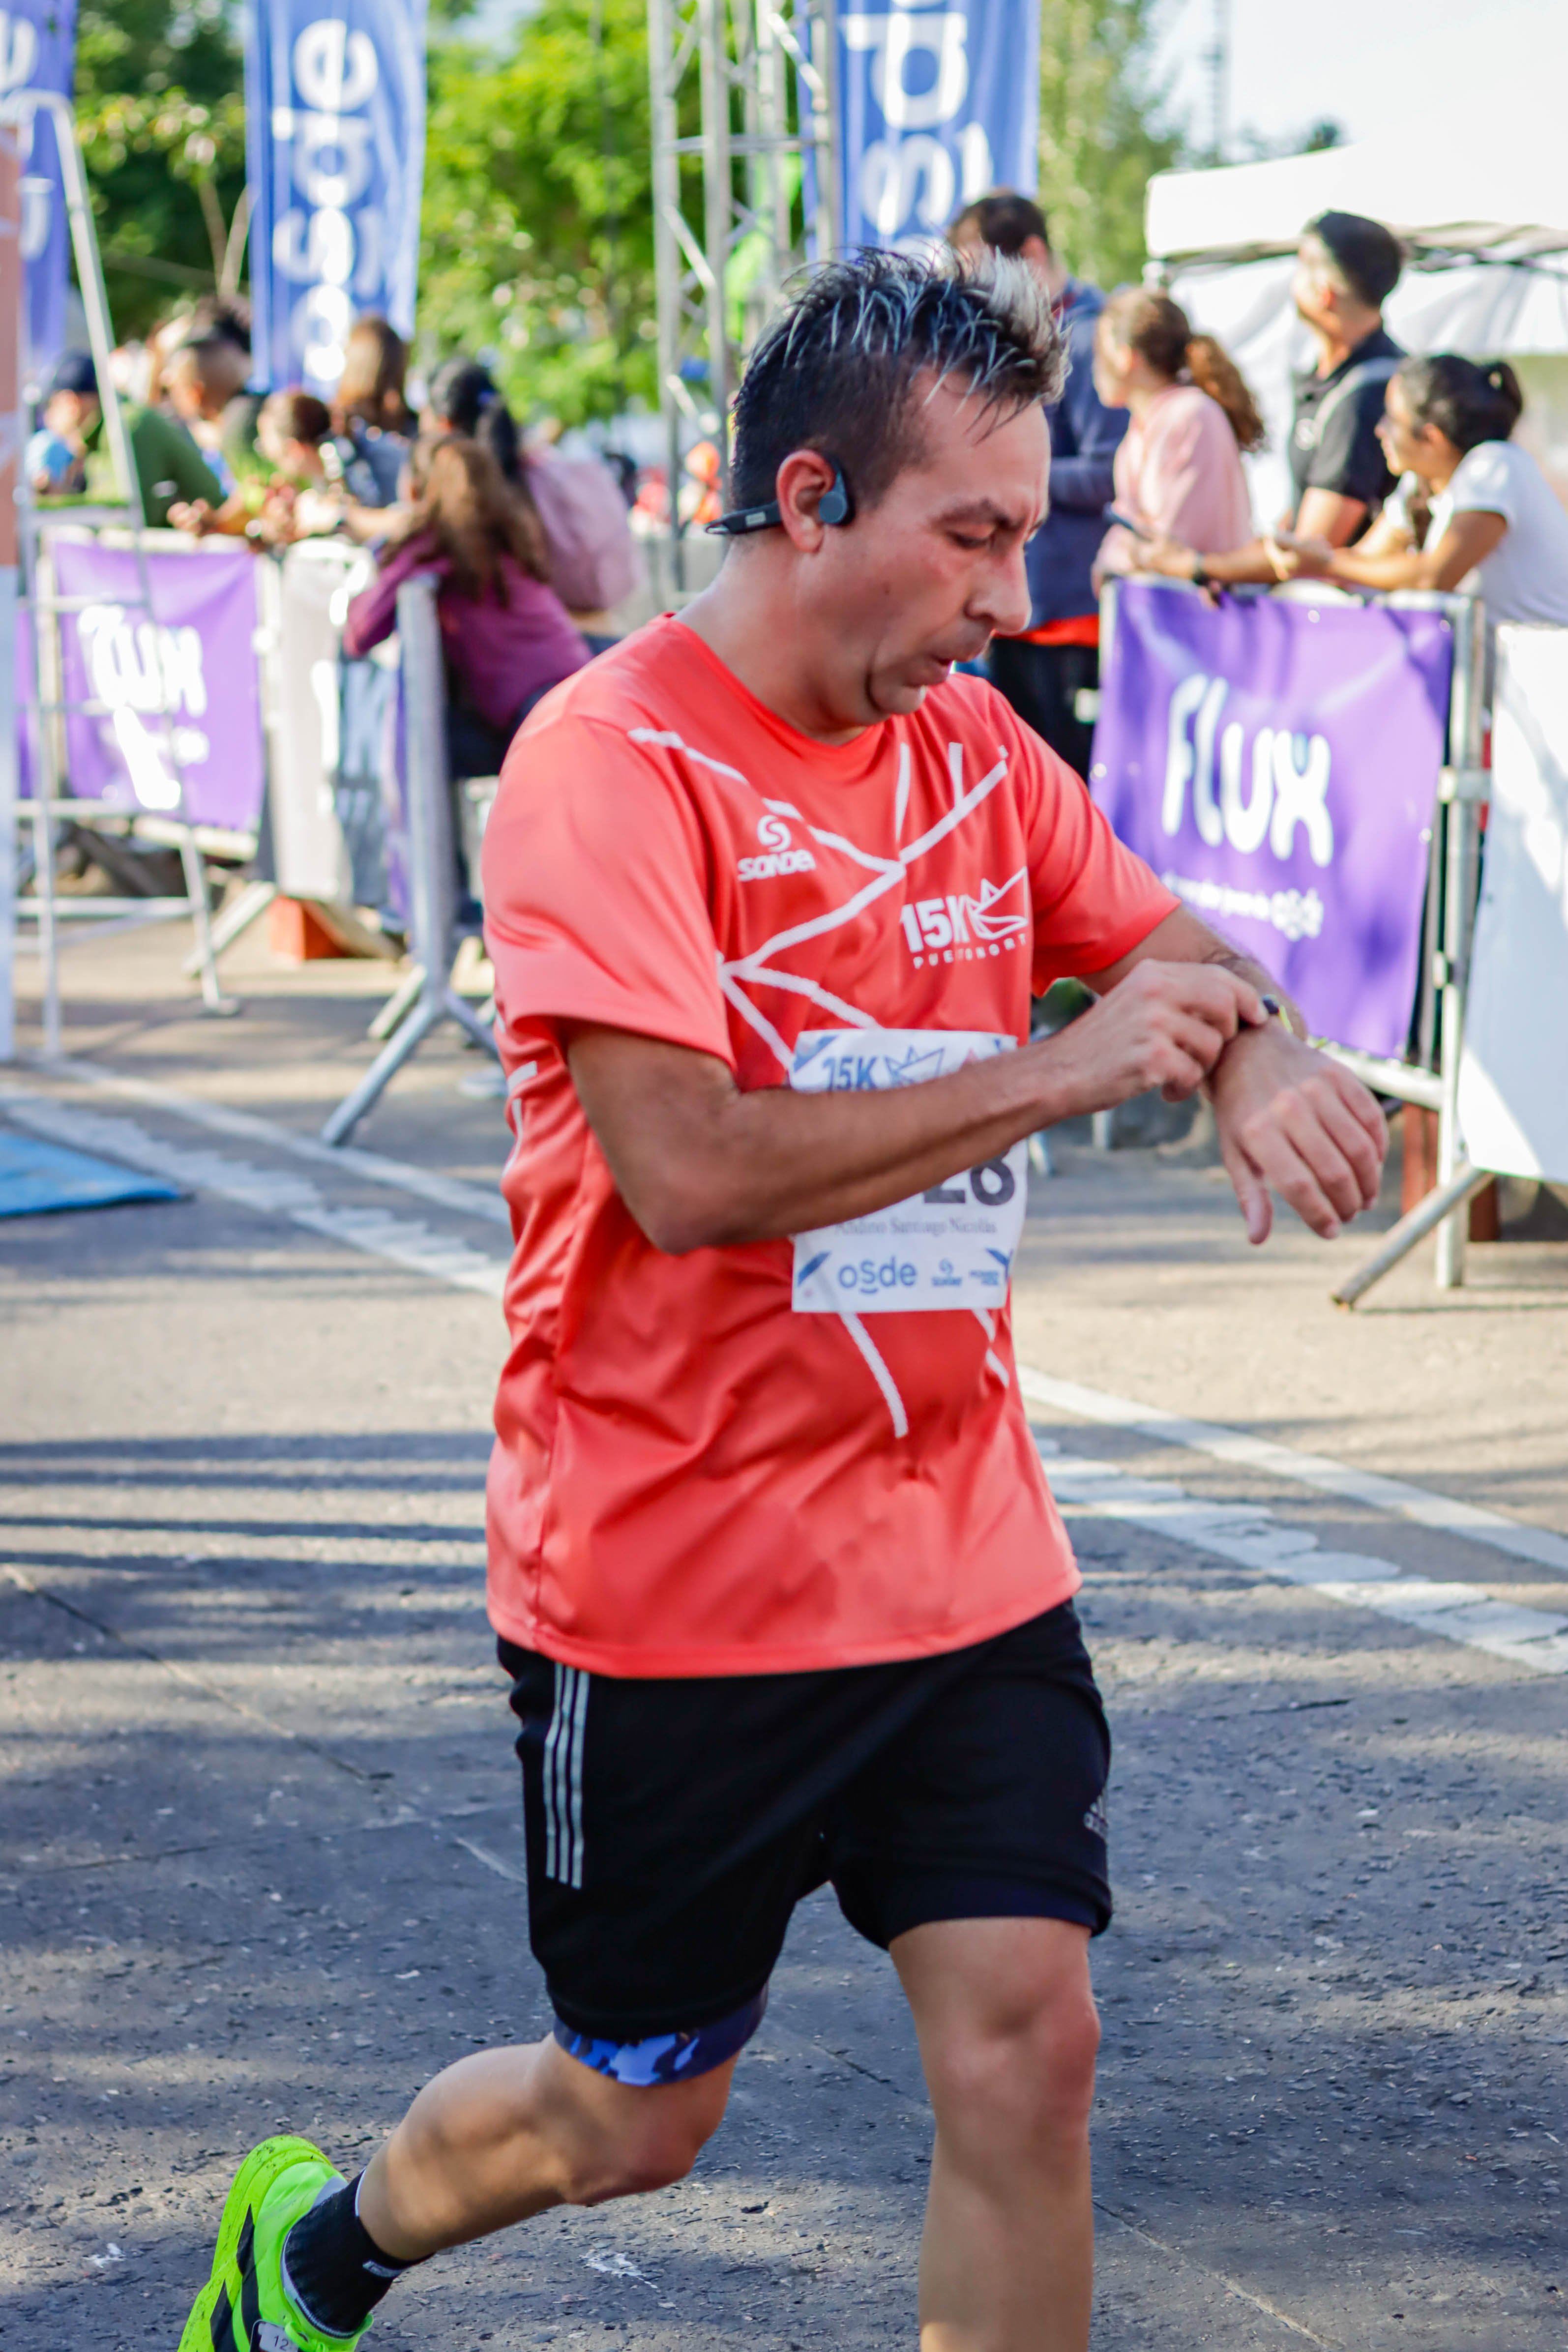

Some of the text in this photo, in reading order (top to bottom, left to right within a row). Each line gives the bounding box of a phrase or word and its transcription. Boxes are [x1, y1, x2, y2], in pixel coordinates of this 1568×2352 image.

[271, 18, 380, 382] osde
[900, 894, 970, 953] 15K
[822, 1056, 878, 1090] 15K
[923, 1148, 1015, 1206] 8
[838, 1255, 917, 1290] osde
